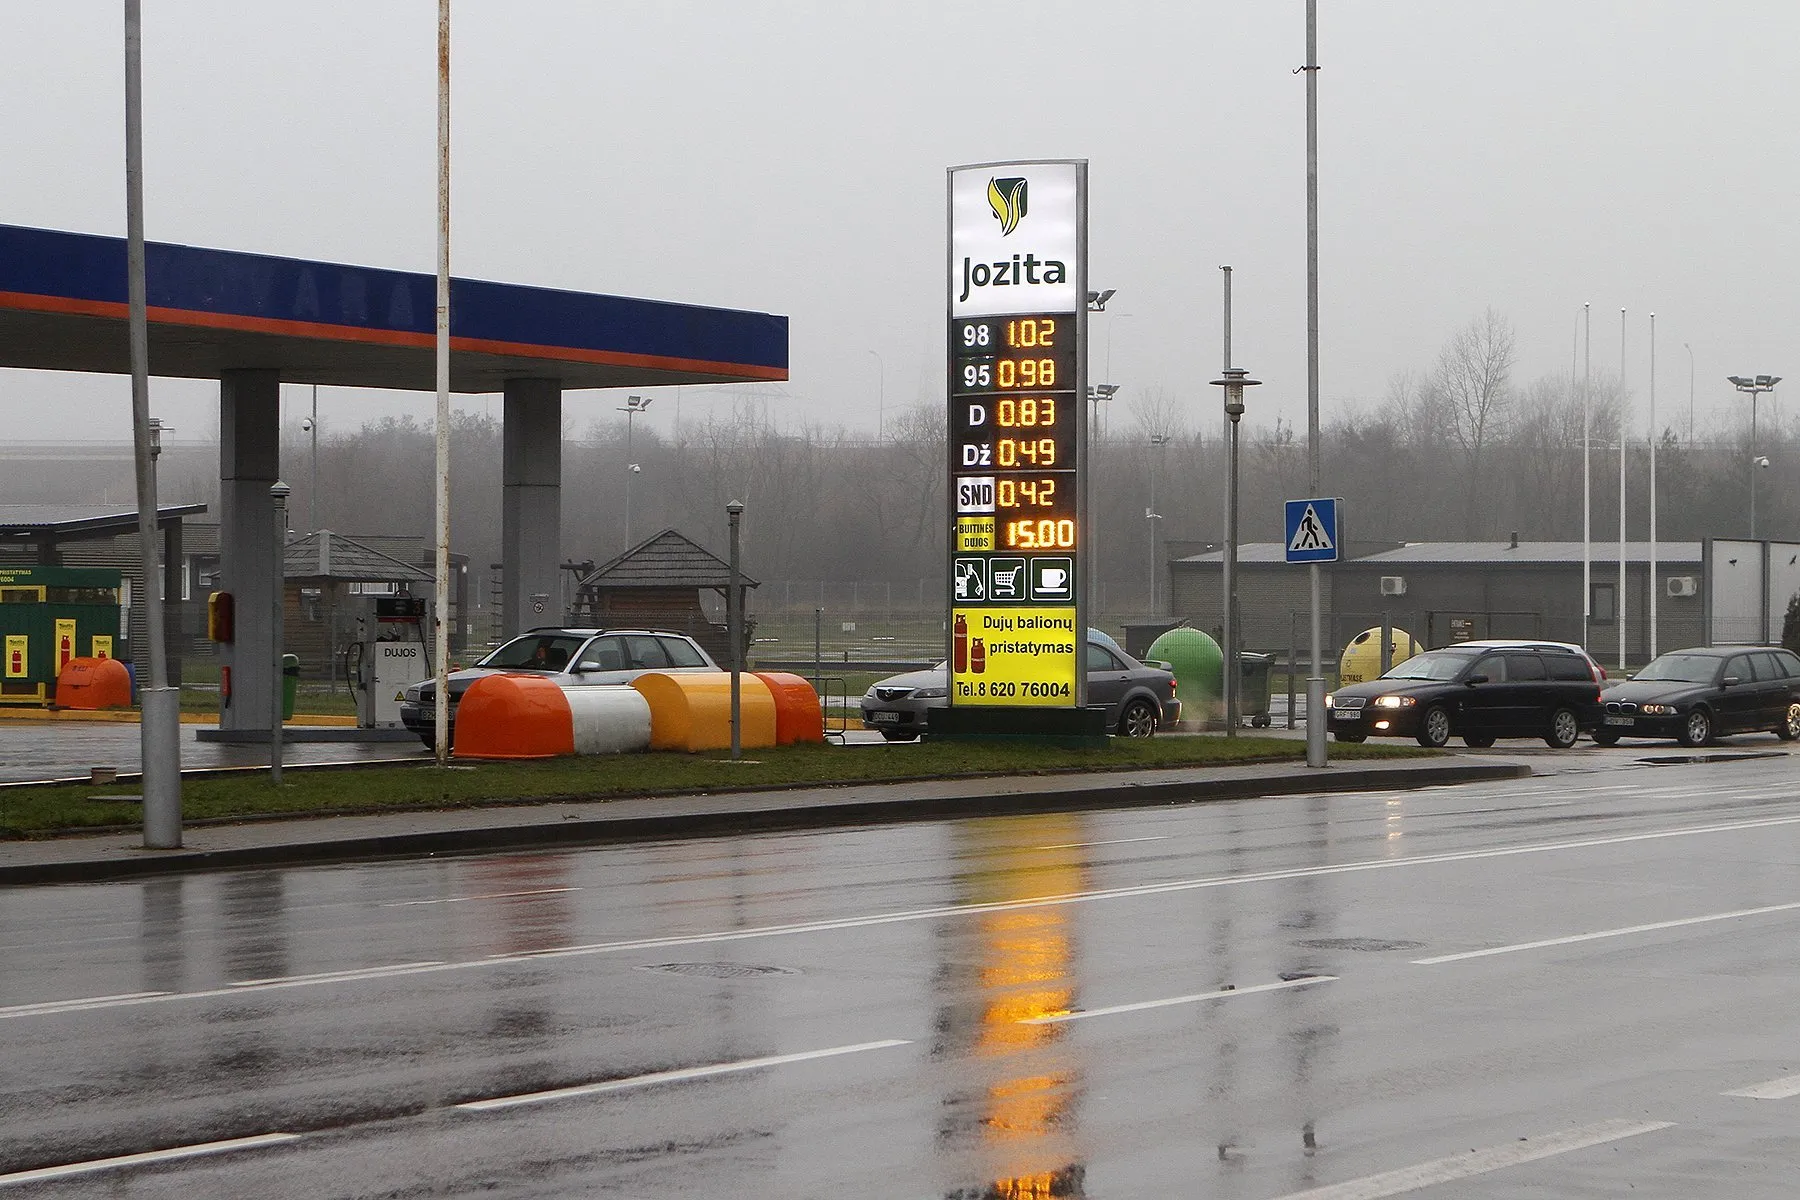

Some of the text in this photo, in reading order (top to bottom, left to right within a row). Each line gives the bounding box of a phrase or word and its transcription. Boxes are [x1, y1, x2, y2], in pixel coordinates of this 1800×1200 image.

[960, 253, 1066, 303] Jozita
[963, 319, 1055, 348] 98 1.02
[963, 359, 1055, 388] 95 0.98
[969, 398, 1055, 427] D 0.83
[962, 438, 1055, 467] Dž 0.49
[960, 479, 1055, 508] SND 0.42
[964, 537, 989, 548] DUJOS
[1007, 519, 1074, 548] 15.00
[983, 615, 1073, 632] Dujų balionų
[385, 648, 417, 658] DUJOS
[989, 640, 1074, 657] pristatymas
[990, 682, 1016, 697] 620
[1021, 682, 1071, 697] 76004
